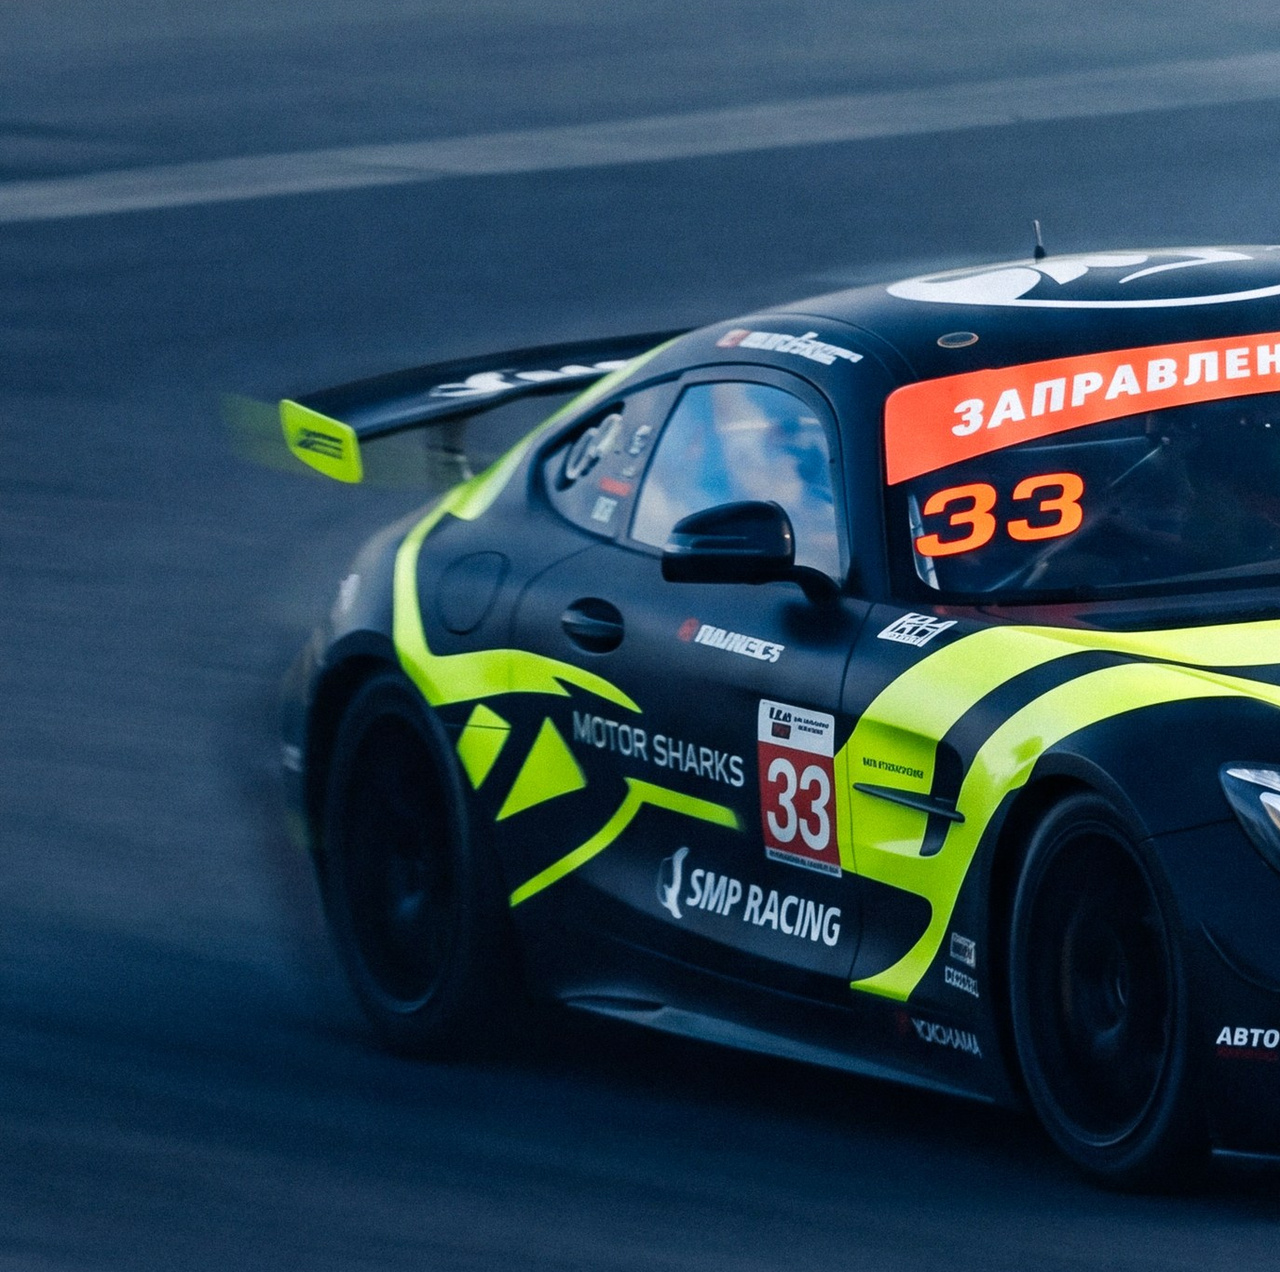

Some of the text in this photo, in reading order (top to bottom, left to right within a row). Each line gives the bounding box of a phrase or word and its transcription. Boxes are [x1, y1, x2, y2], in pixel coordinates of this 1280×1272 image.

[914, 472, 1085, 559] 33
[573, 708, 745, 788] MOTOR SHARKS
[767, 757, 831, 851] 33
[685, 867, 842, 947] SMP RACING
[1215, 1026, 1280, 1048] АВТО
